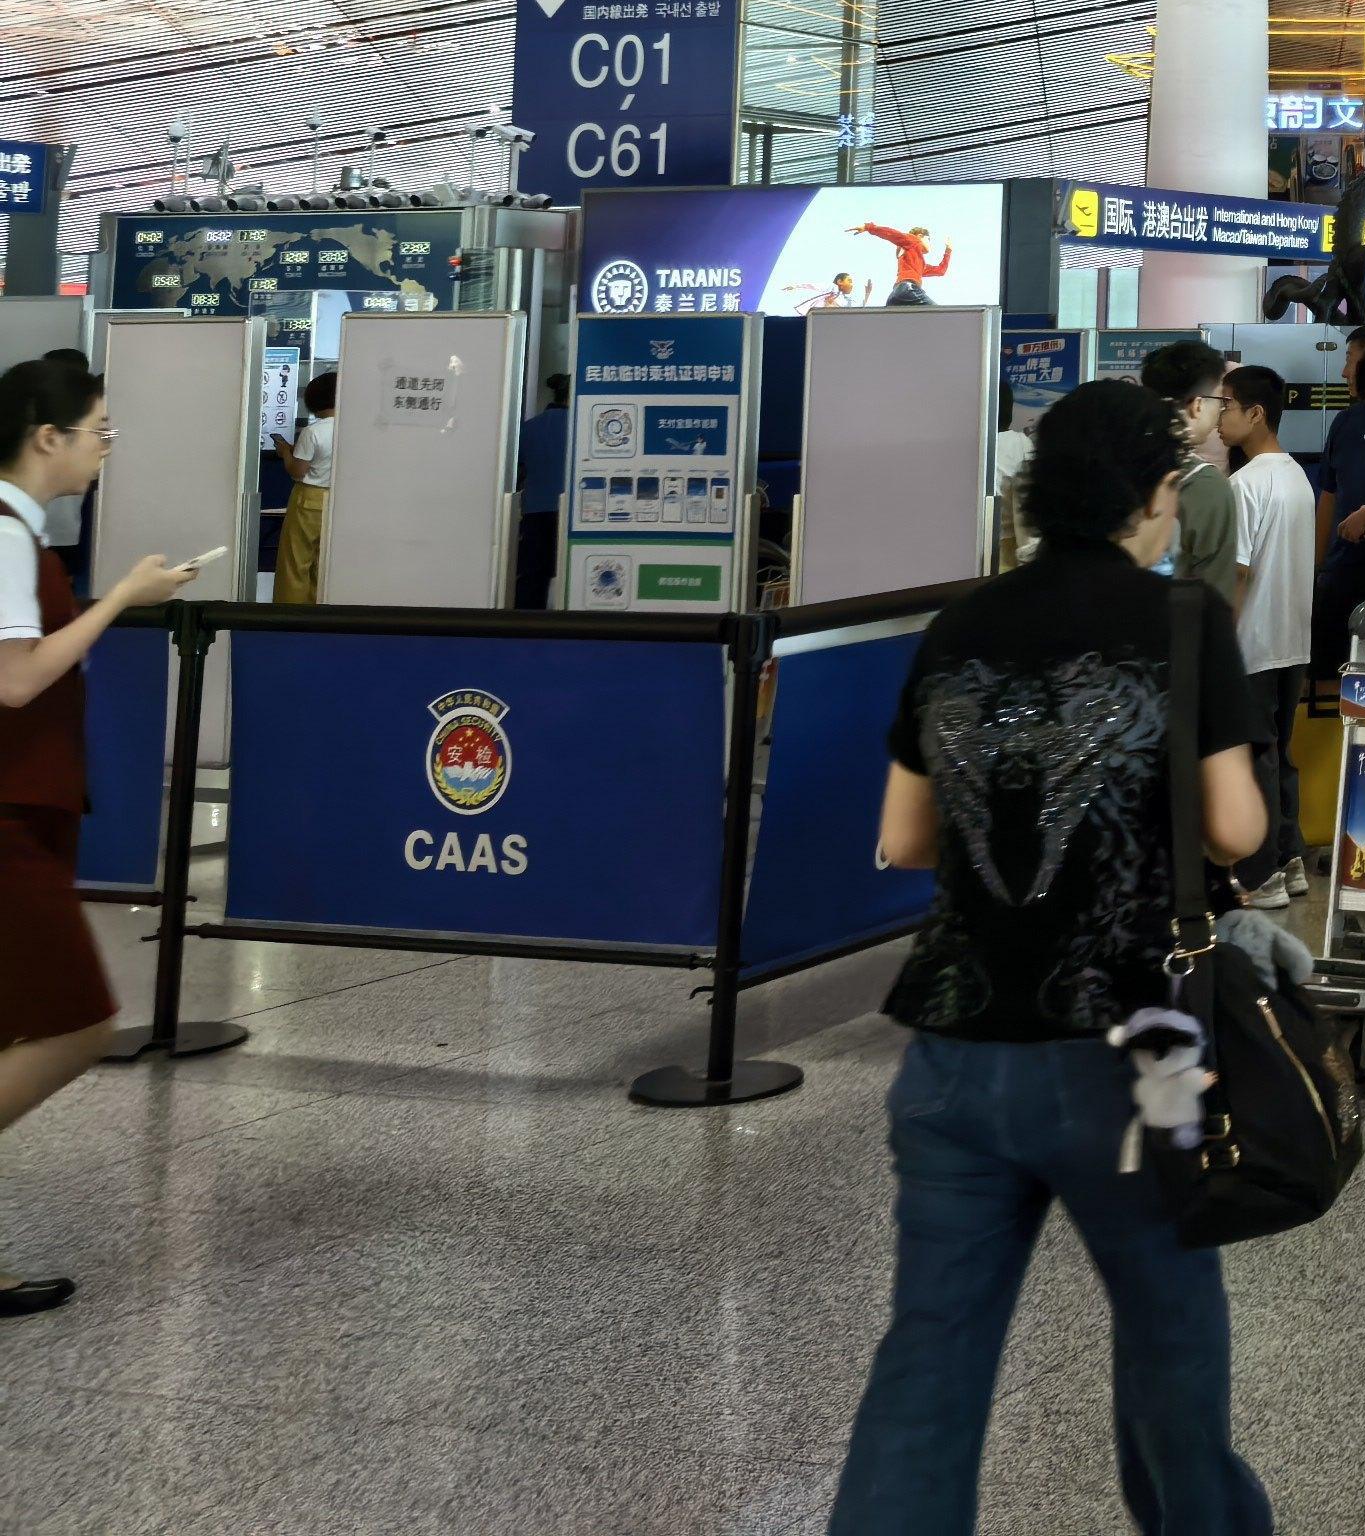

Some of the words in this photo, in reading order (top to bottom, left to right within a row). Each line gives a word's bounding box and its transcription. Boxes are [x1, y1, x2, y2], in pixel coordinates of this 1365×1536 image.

[655, 2, 691, 18] 국내선
[695, 1, 721, 17] 출발
[570, 32, 671, 89] C01
[566, 121, 668, 179] C61
[1103, 196, 1208, 243] 国际、港澳台出发
[1213, 206, 1260, 225] International
[1261, 212, 1275, 226] and
[1276, 213, 1297, 231] Hong
[1297, 217, 1320, 234] Kong/
[1213, 229, 1267, 246] Macao/Taiwan
[1268, 233, 1309, 250] Departures
[656, 268, 742, 288] TARANIS
[654, 293, 741, 312] 泰兰尼斯
[585, 365, 735, 383] 民航临时乘机证明申请
[404, 829, 529, 876] CAAS
